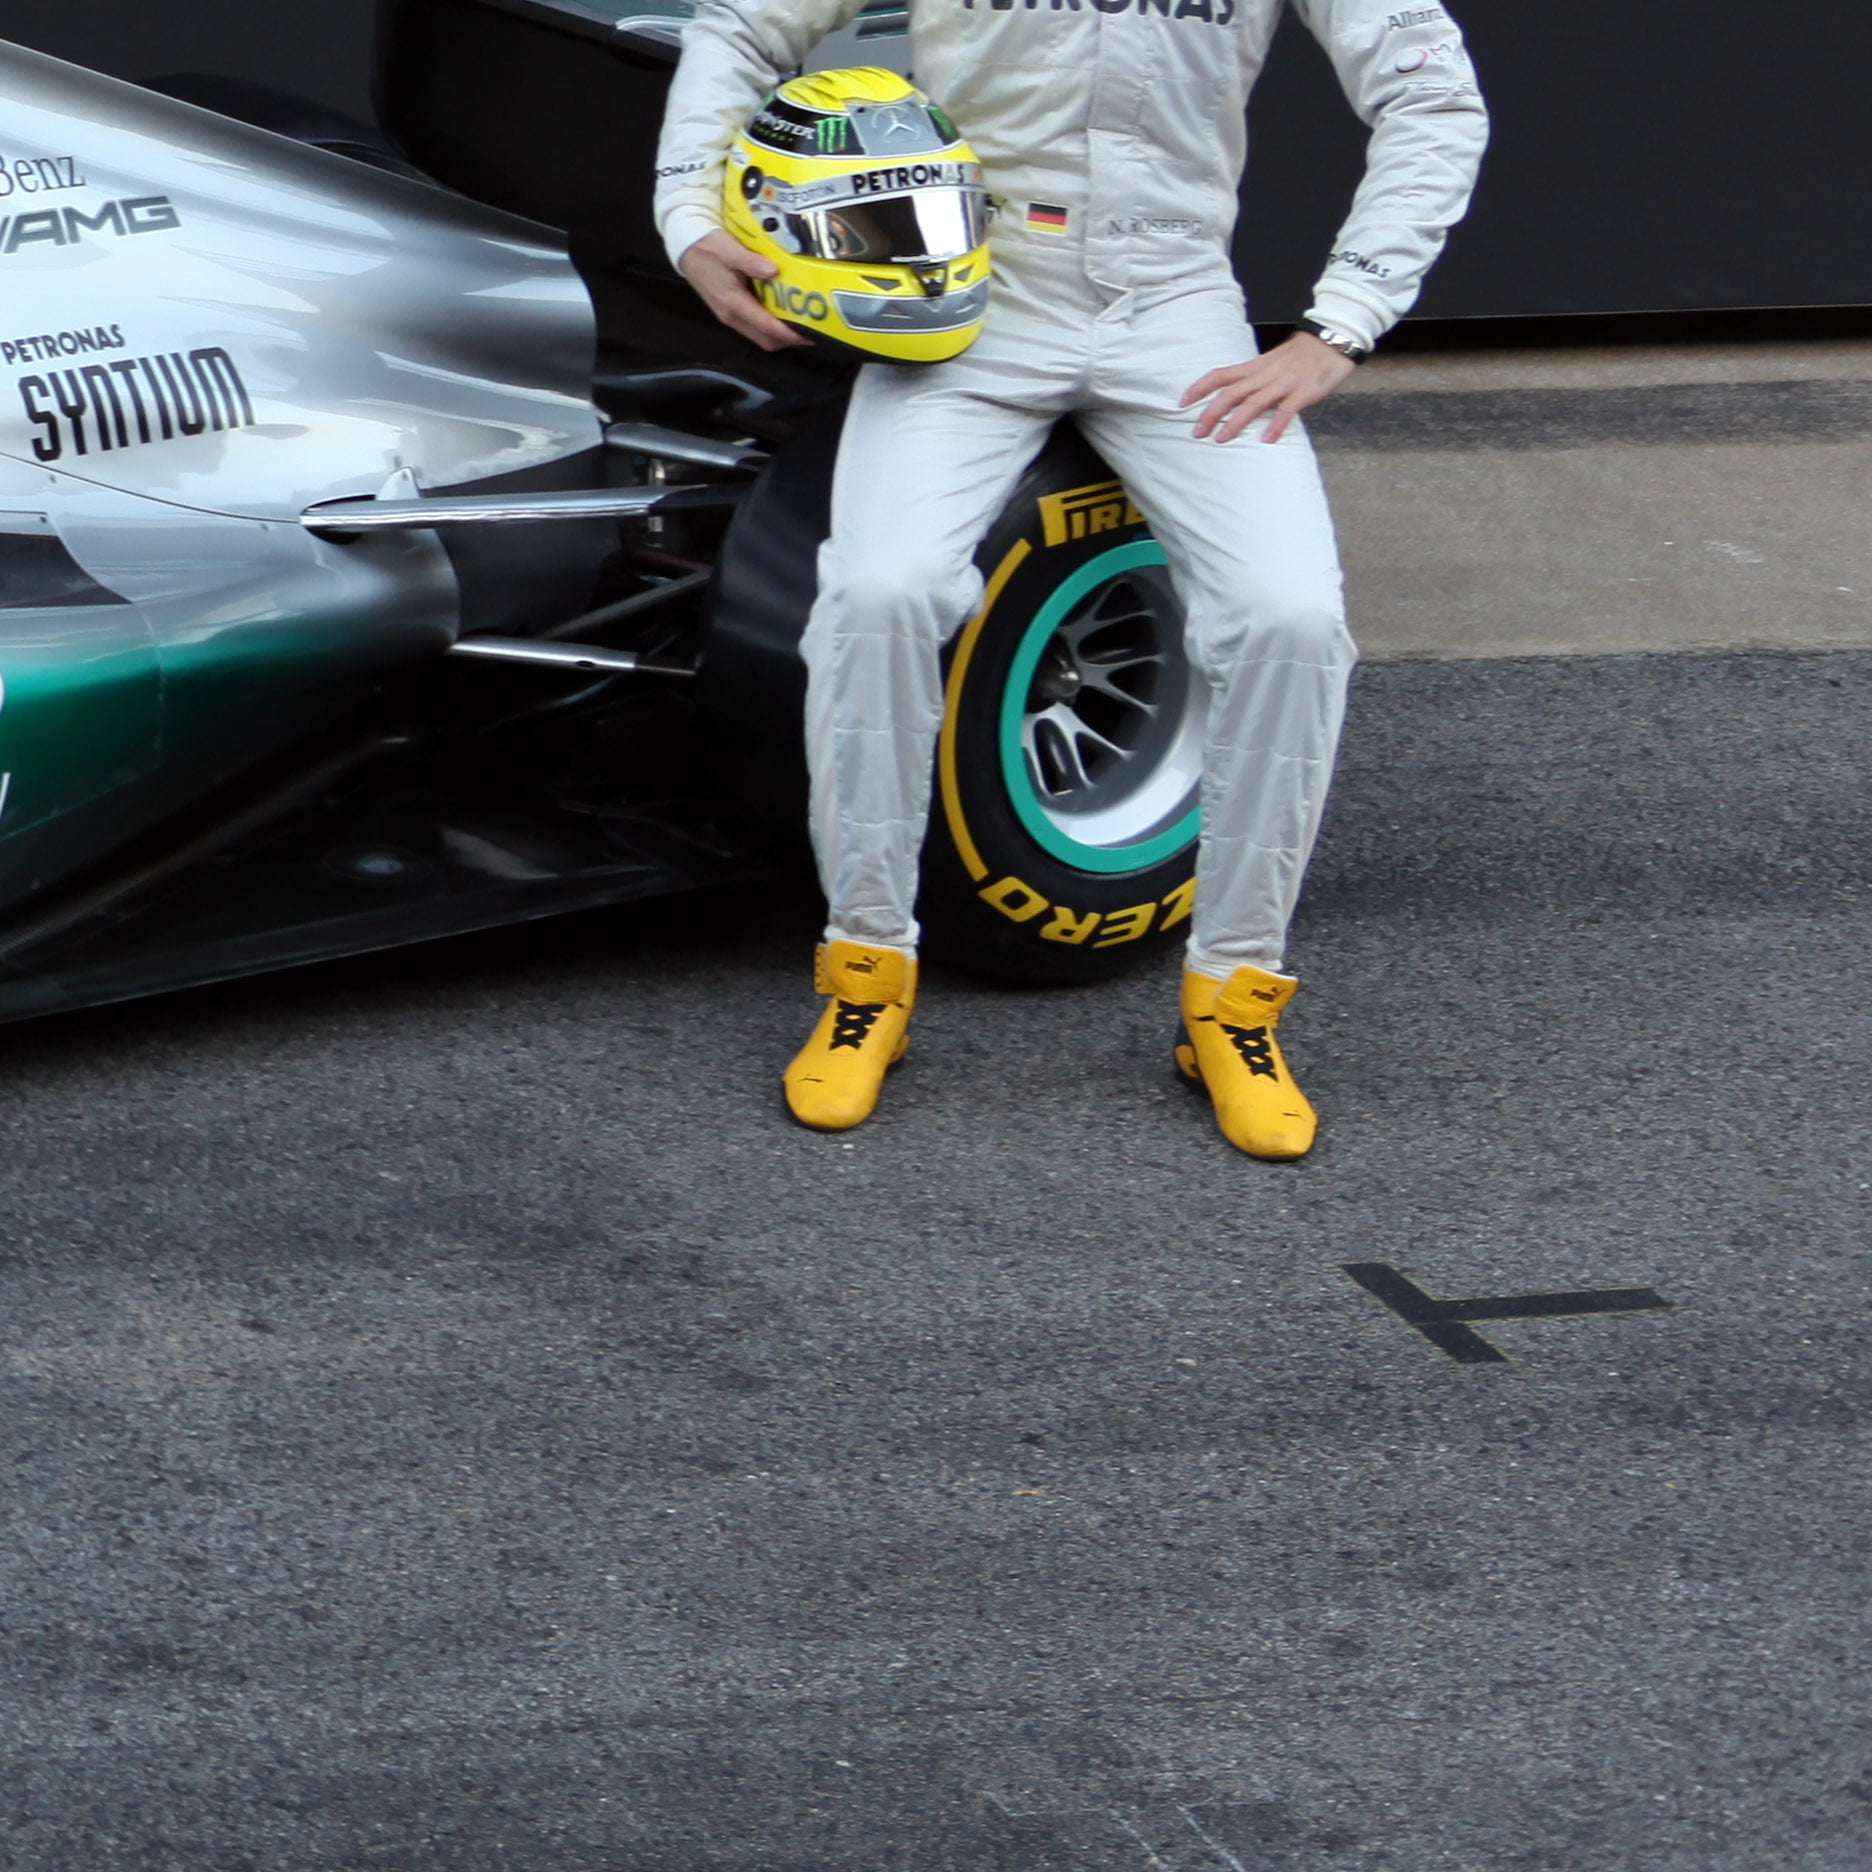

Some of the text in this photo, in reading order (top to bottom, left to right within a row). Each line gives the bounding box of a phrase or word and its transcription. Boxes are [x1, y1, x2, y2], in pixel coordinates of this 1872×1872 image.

[851, 164, 964, 195] PETRONAS
[2, 195, 180, 254] AMG
[0, 324, 125, 365] PETRONAS
[18, 346, 254, 462] SYNTIUM
